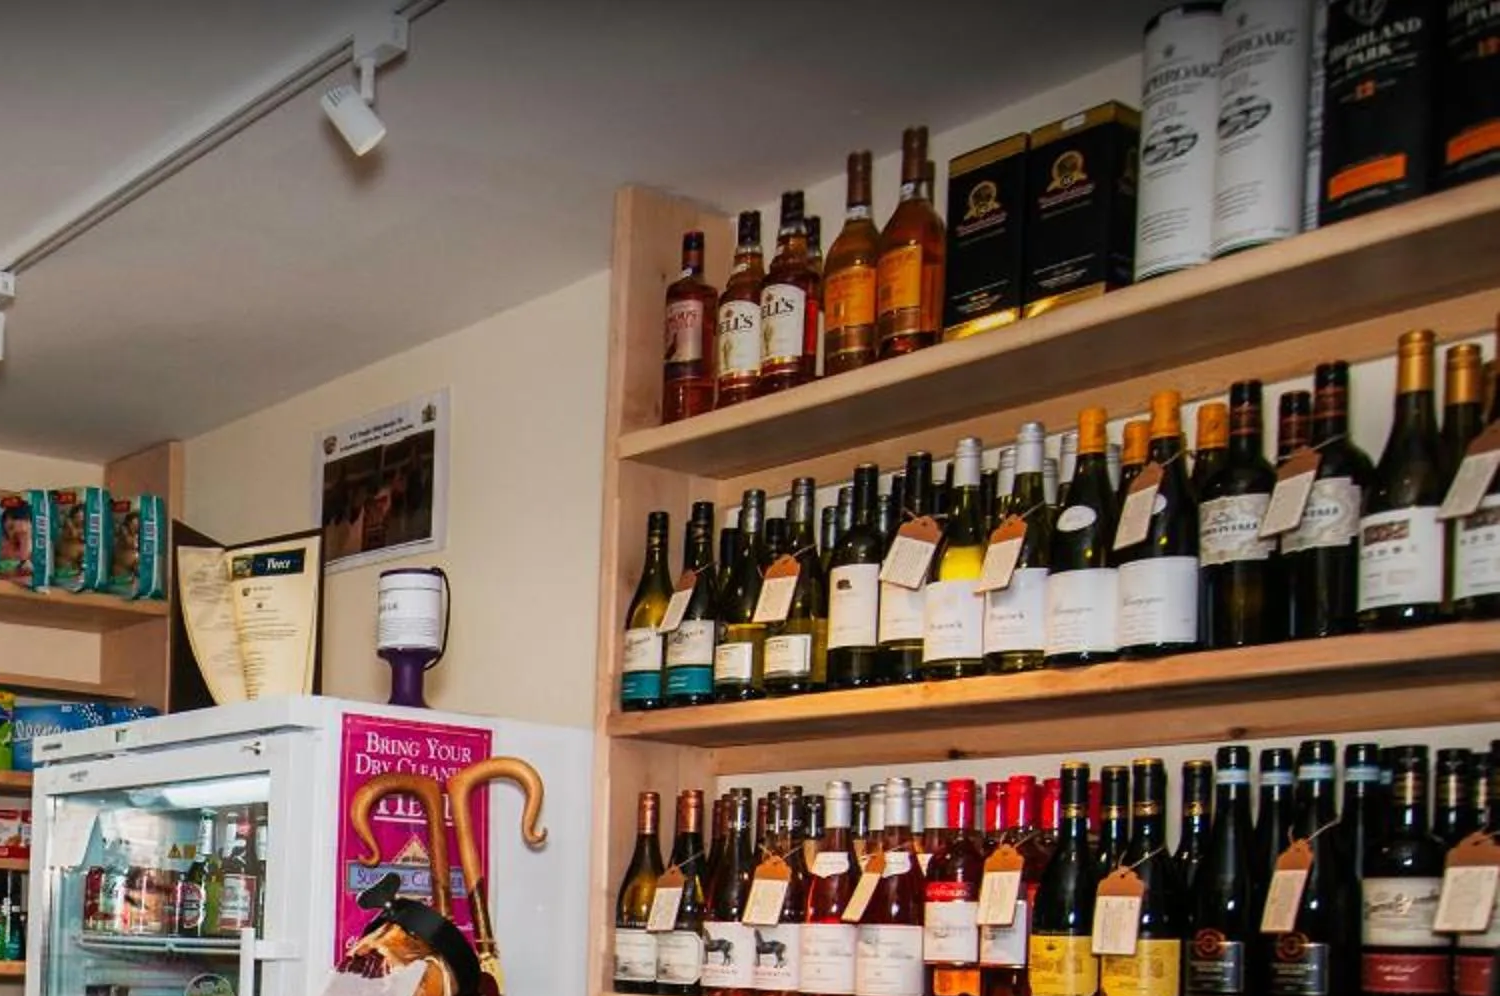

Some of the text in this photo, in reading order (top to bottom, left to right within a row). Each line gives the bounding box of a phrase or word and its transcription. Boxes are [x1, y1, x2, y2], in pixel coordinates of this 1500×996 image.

[761, 297, 795, 319] ELL'S
[718, 312, 754, 334] ELL'S
[366, 731, 472, 764] BRING YOUR
[355, 752, 392, 776] DRY
